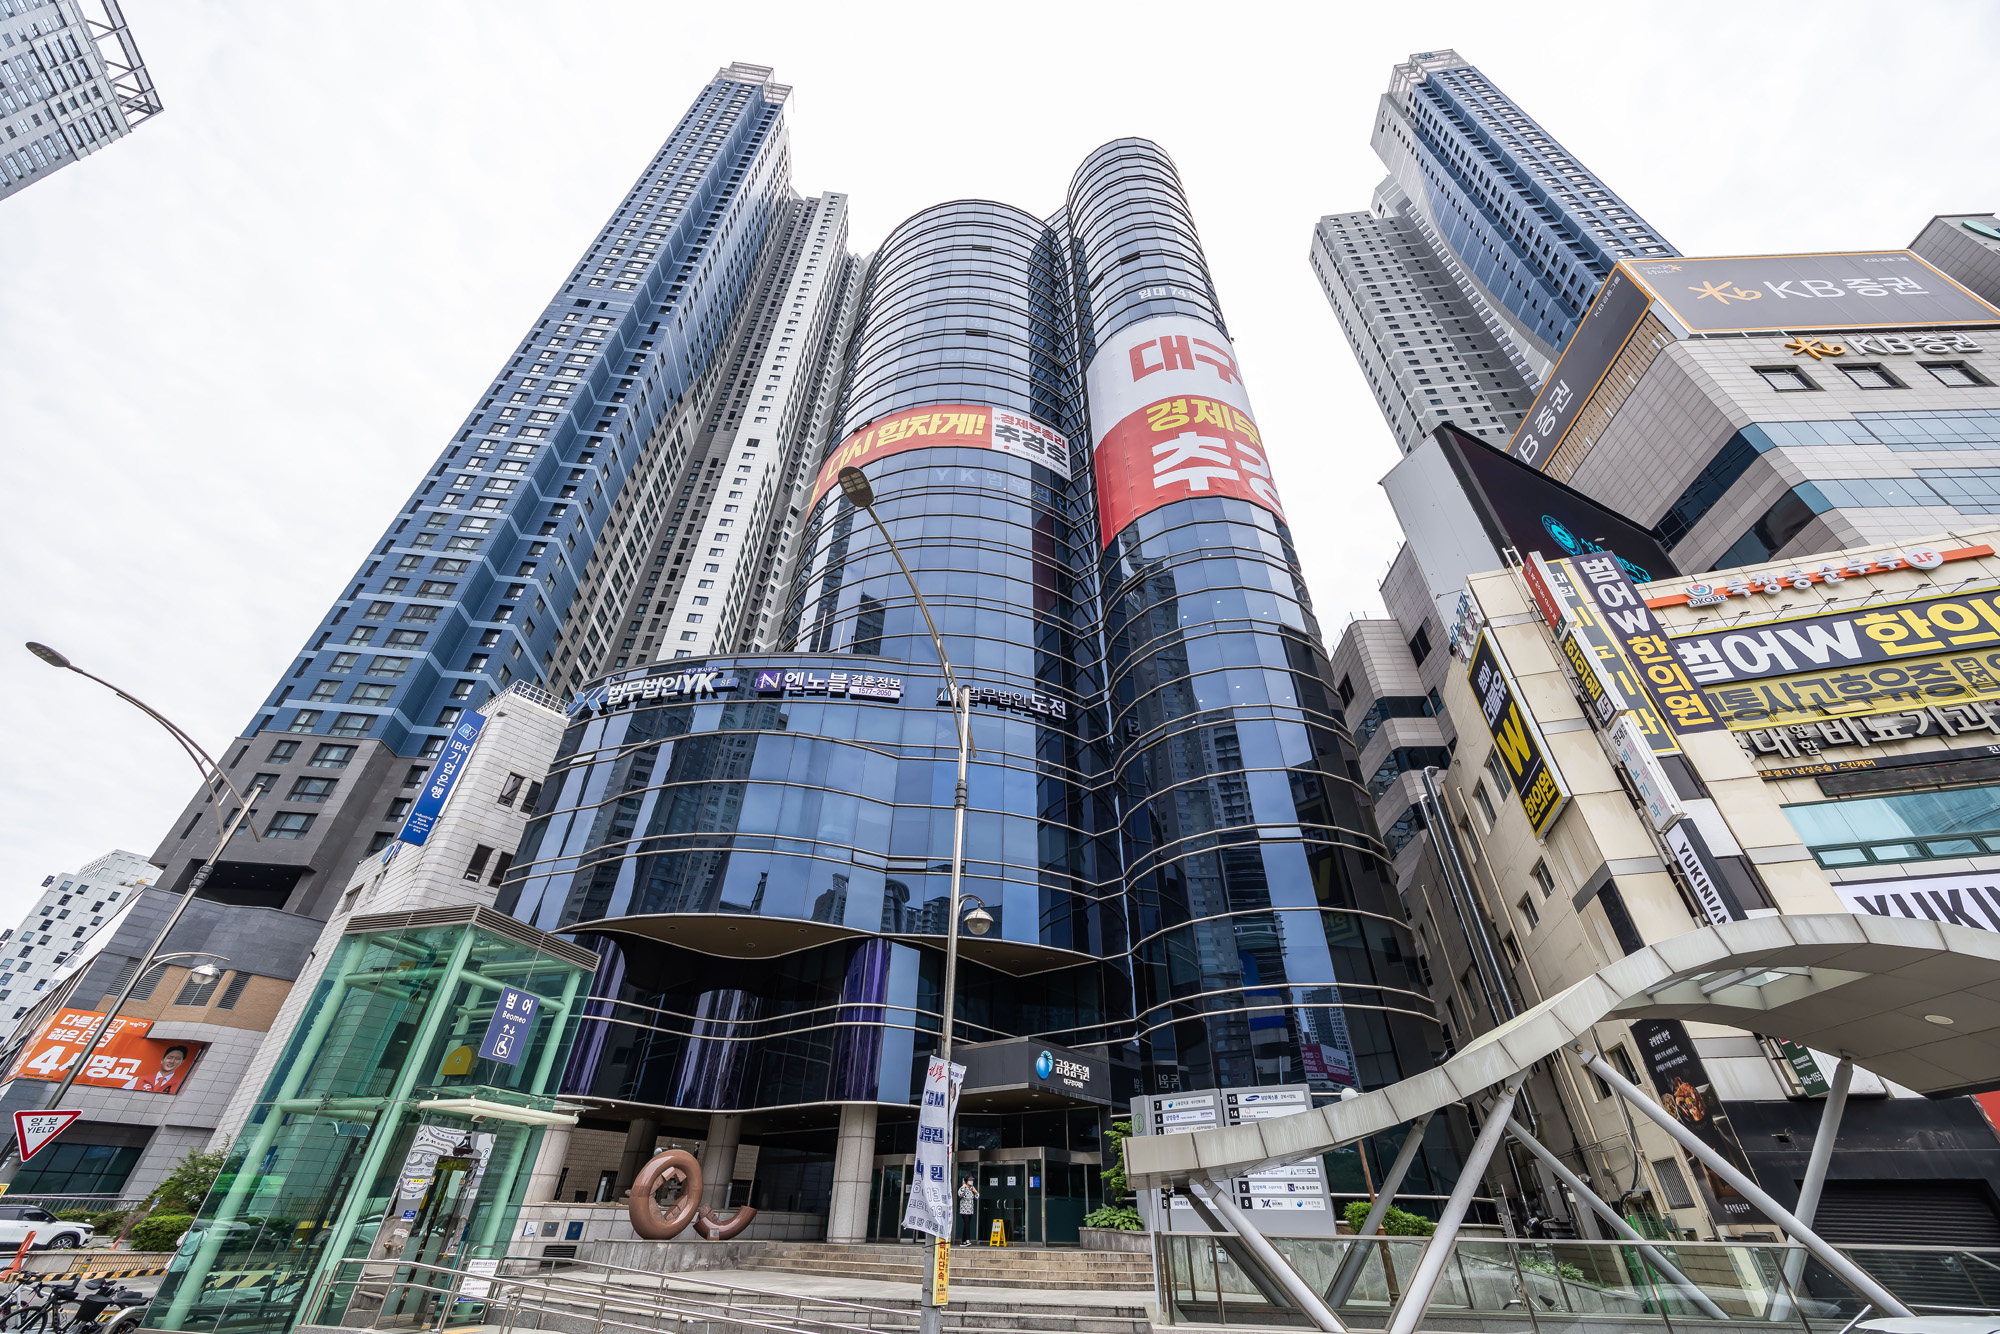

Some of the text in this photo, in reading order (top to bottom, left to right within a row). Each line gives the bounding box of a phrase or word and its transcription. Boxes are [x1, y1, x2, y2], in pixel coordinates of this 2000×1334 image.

[1139, 287, 1166, 299] 임대
[1763, 276, 1930, 300] KB증권
[1845, 333, 1984, 355] KB증권
[1000, 413, 1066, 449] 경제부총리
[1514, 379, 1574, 465] B증권
[825, 413, 987, 482] 다시 힘차게!
[995, 424, 1068, 468] 추경호
[1726, 552, 1934, 598] 북창동순두부 1F
[1690, 593, 1727, 606] DKORE
[1677, 597, 2000, 683] 범어W한의
[720, 678, 732, 687] 8F
[784, 672, 849, 693] 엔노블
[851, 674, 901, 689] 결혼정보
[1564, 635, 1610, 716] 한의원 4F
[858, 687, 892, 697] 1577-2050
[1482, 670, 1507, 728] 더블유
[1029, 693, 1067, 720] 도전
[450, 740, 471, 754] IBK
[1496, 700, 1531, 776] W
[431, 751, 462, 799] 기업은행
[1795, 762, 1833, 774] 남성수술
[1838, 759, 1876, 770] 스킨케어
[1524, 766, 1557, 825] 한의원
[505, 992, 534, 1015] 범어
[60, 1014, 94, 1028] 다른
[502, 1010, 527, 1024] Beomeo
[46, 1028, 80, 1042] 젊은
[26, 1045, 66, 1075] 4
[1055, 1059, 1090, 1081] 금융감독원
[162, 1085, 172, 1094] 4
[27, 1126, 55, 1134] YIELD
[31, 1117, 58, 1127] 양보
